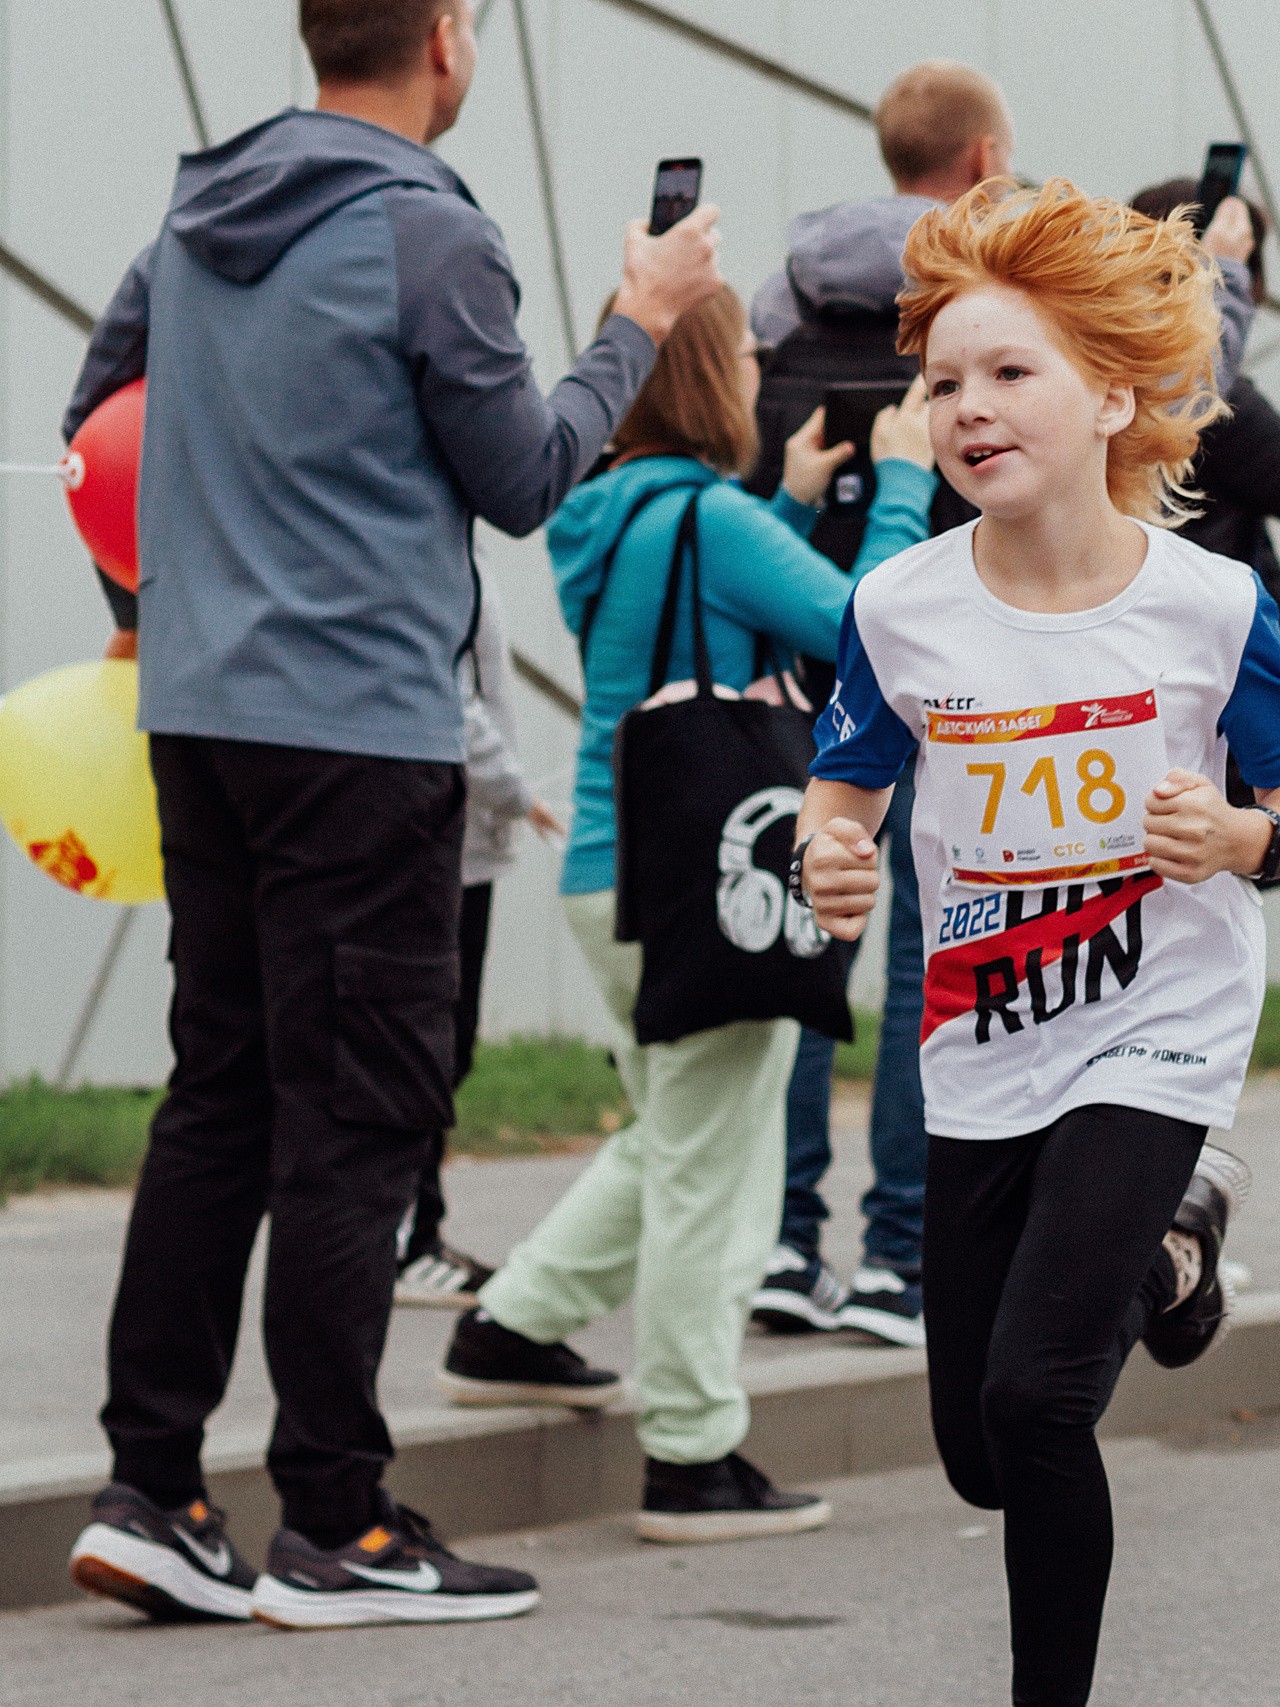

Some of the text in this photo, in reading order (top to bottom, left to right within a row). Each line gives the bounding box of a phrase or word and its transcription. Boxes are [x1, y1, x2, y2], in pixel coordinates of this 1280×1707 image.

[936, 714, 1042, 736] ДЕТСКИЙ ЗАБЕГ
[966, 749, 1126, 834] 718
[939, 893, 1002, 944] 2022
[973, 893, 1143, 1045] RUN
